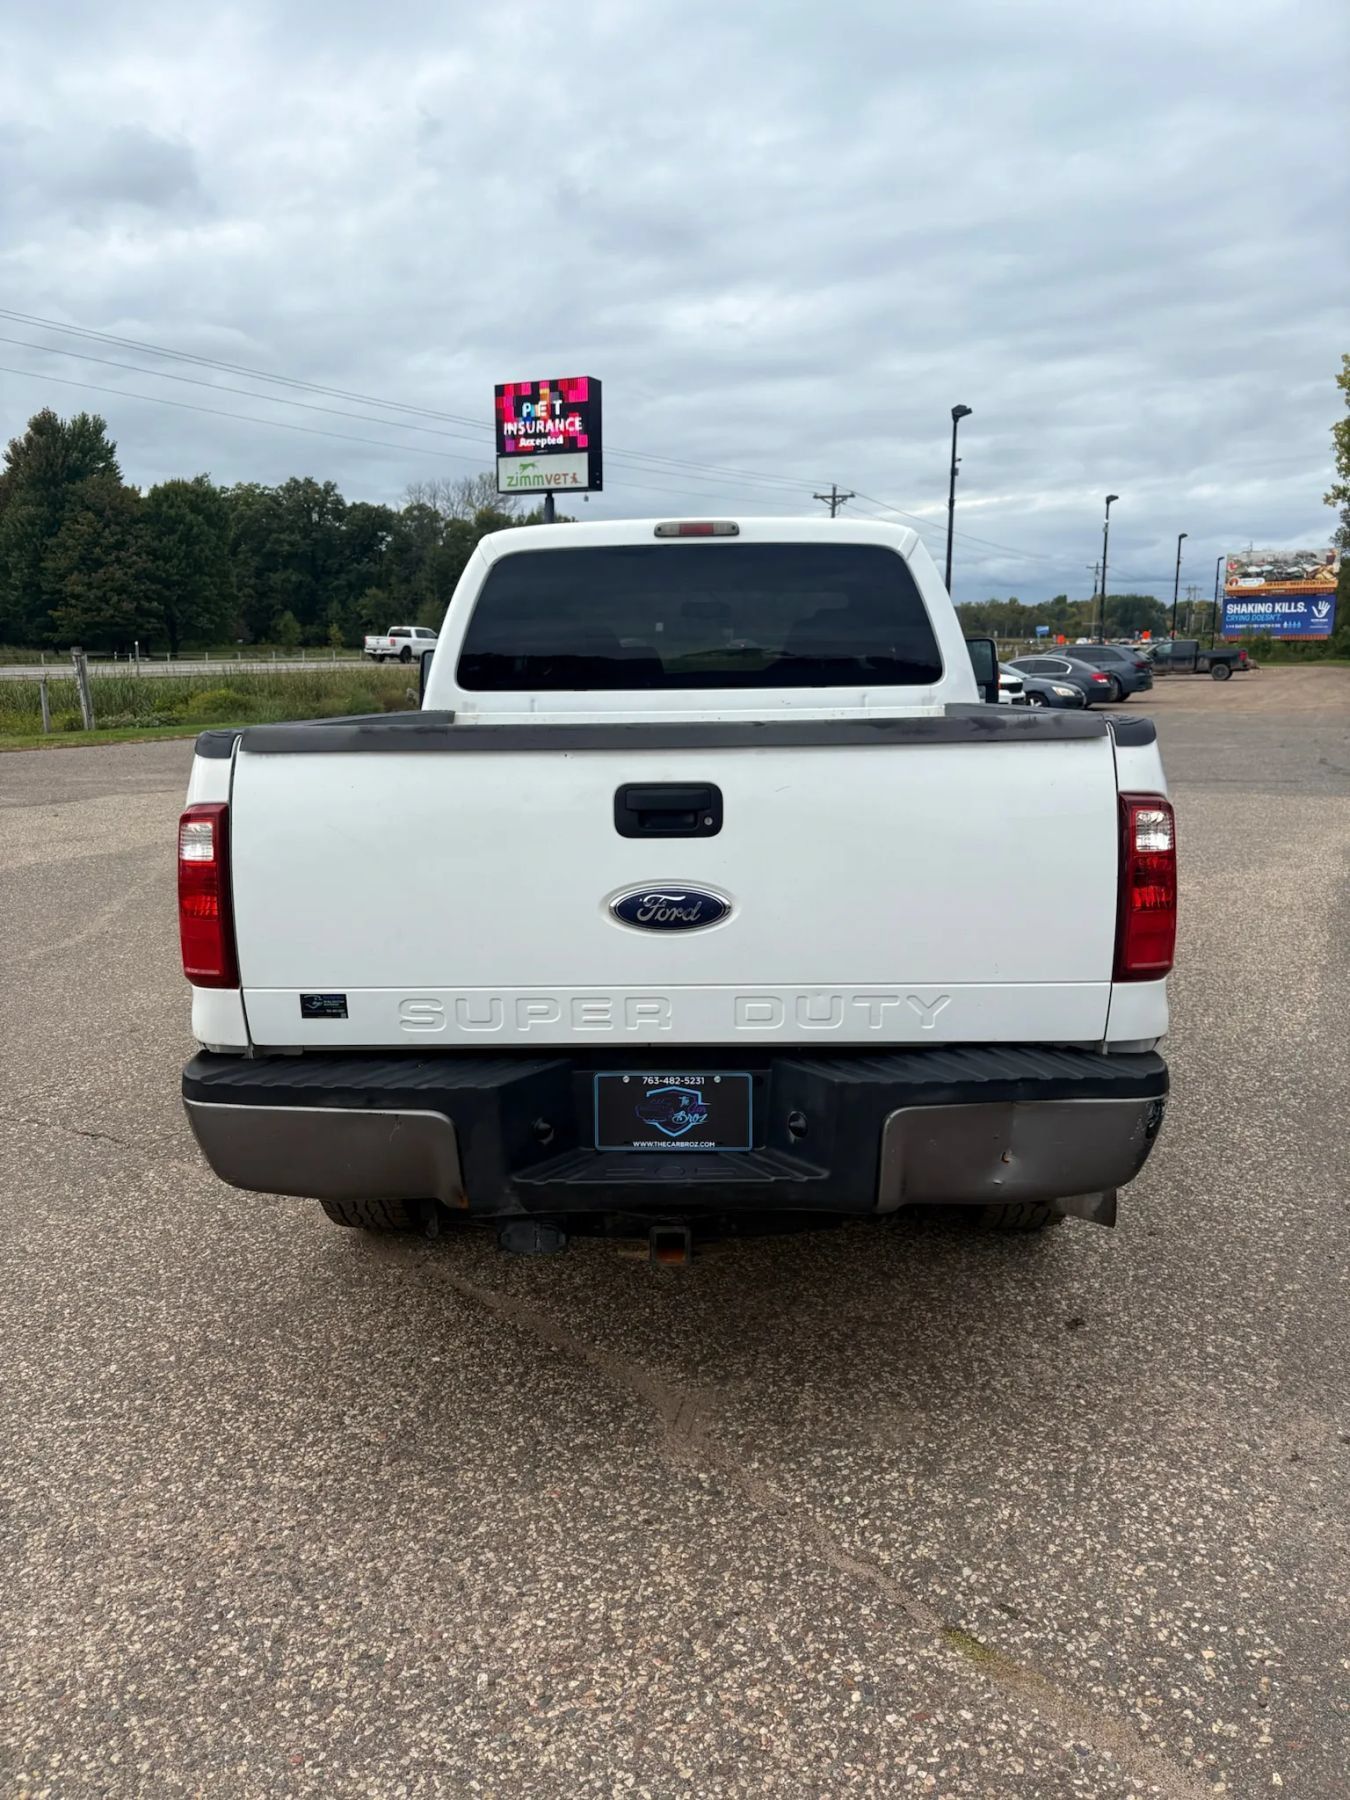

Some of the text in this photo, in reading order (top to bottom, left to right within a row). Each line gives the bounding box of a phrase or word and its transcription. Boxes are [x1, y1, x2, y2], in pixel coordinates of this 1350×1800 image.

[522, 400, 562, 417] PET
[504, 417, 582, 435] INSURANCE
[519, 435, 564, 448] Accepted
[1226, 602, 1308, 614] SHAKING KILLS.
[636, 894, 702, 921] Ford
[397, 993, 952, 1033] SUPER DUTY
[642, 1076, 705, 1085] 763-482-5231
